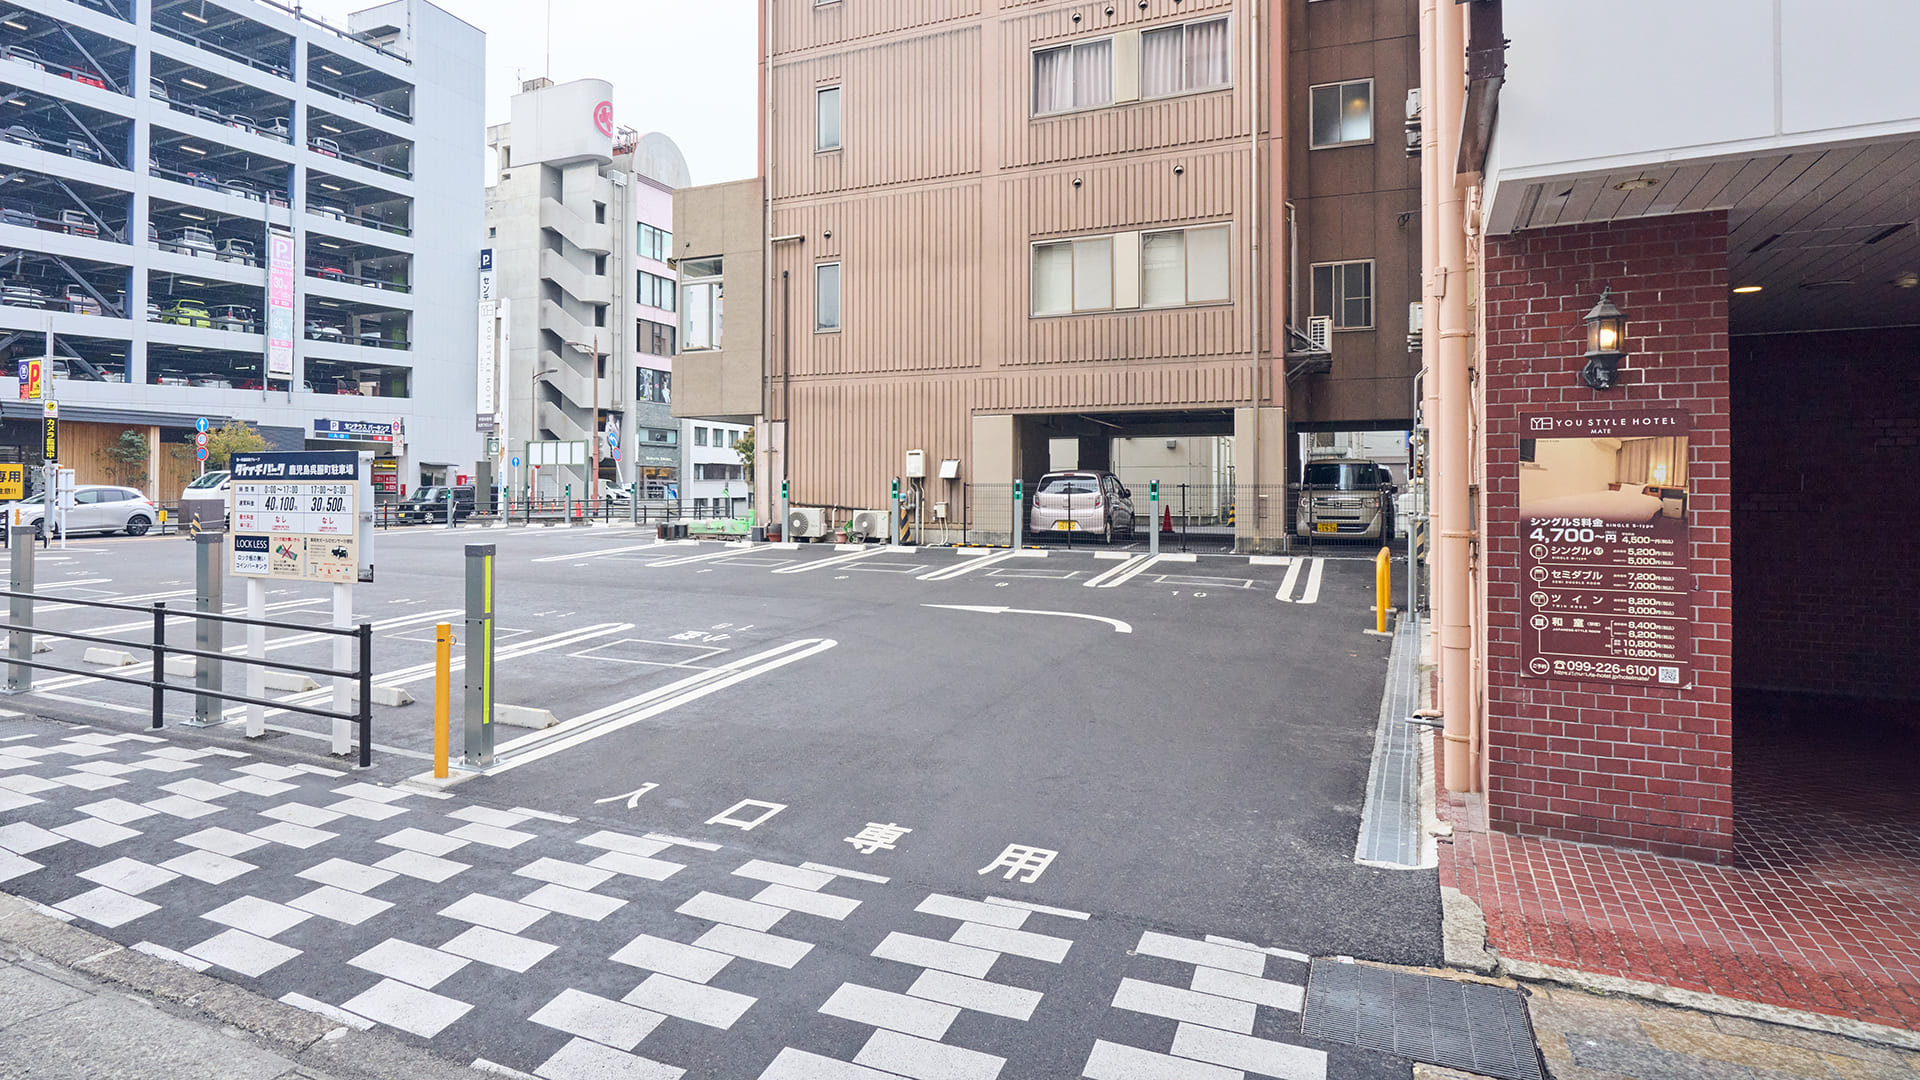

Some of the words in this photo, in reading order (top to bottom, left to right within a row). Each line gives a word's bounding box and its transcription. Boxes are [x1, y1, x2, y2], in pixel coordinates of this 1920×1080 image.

[1556, 419, 1583, 427] YOU
[1588, 418, 1626, 427] STYLE
[1632, 417, 1676, 426] HOTEL
[1530, 517, 1604, 528] シングルS料金
[1551, 546, 1592, 556] シングル
[1551, 570, 1603, 580] セミダブル
[1567, 661, 1657, 677] 099-226-6100
